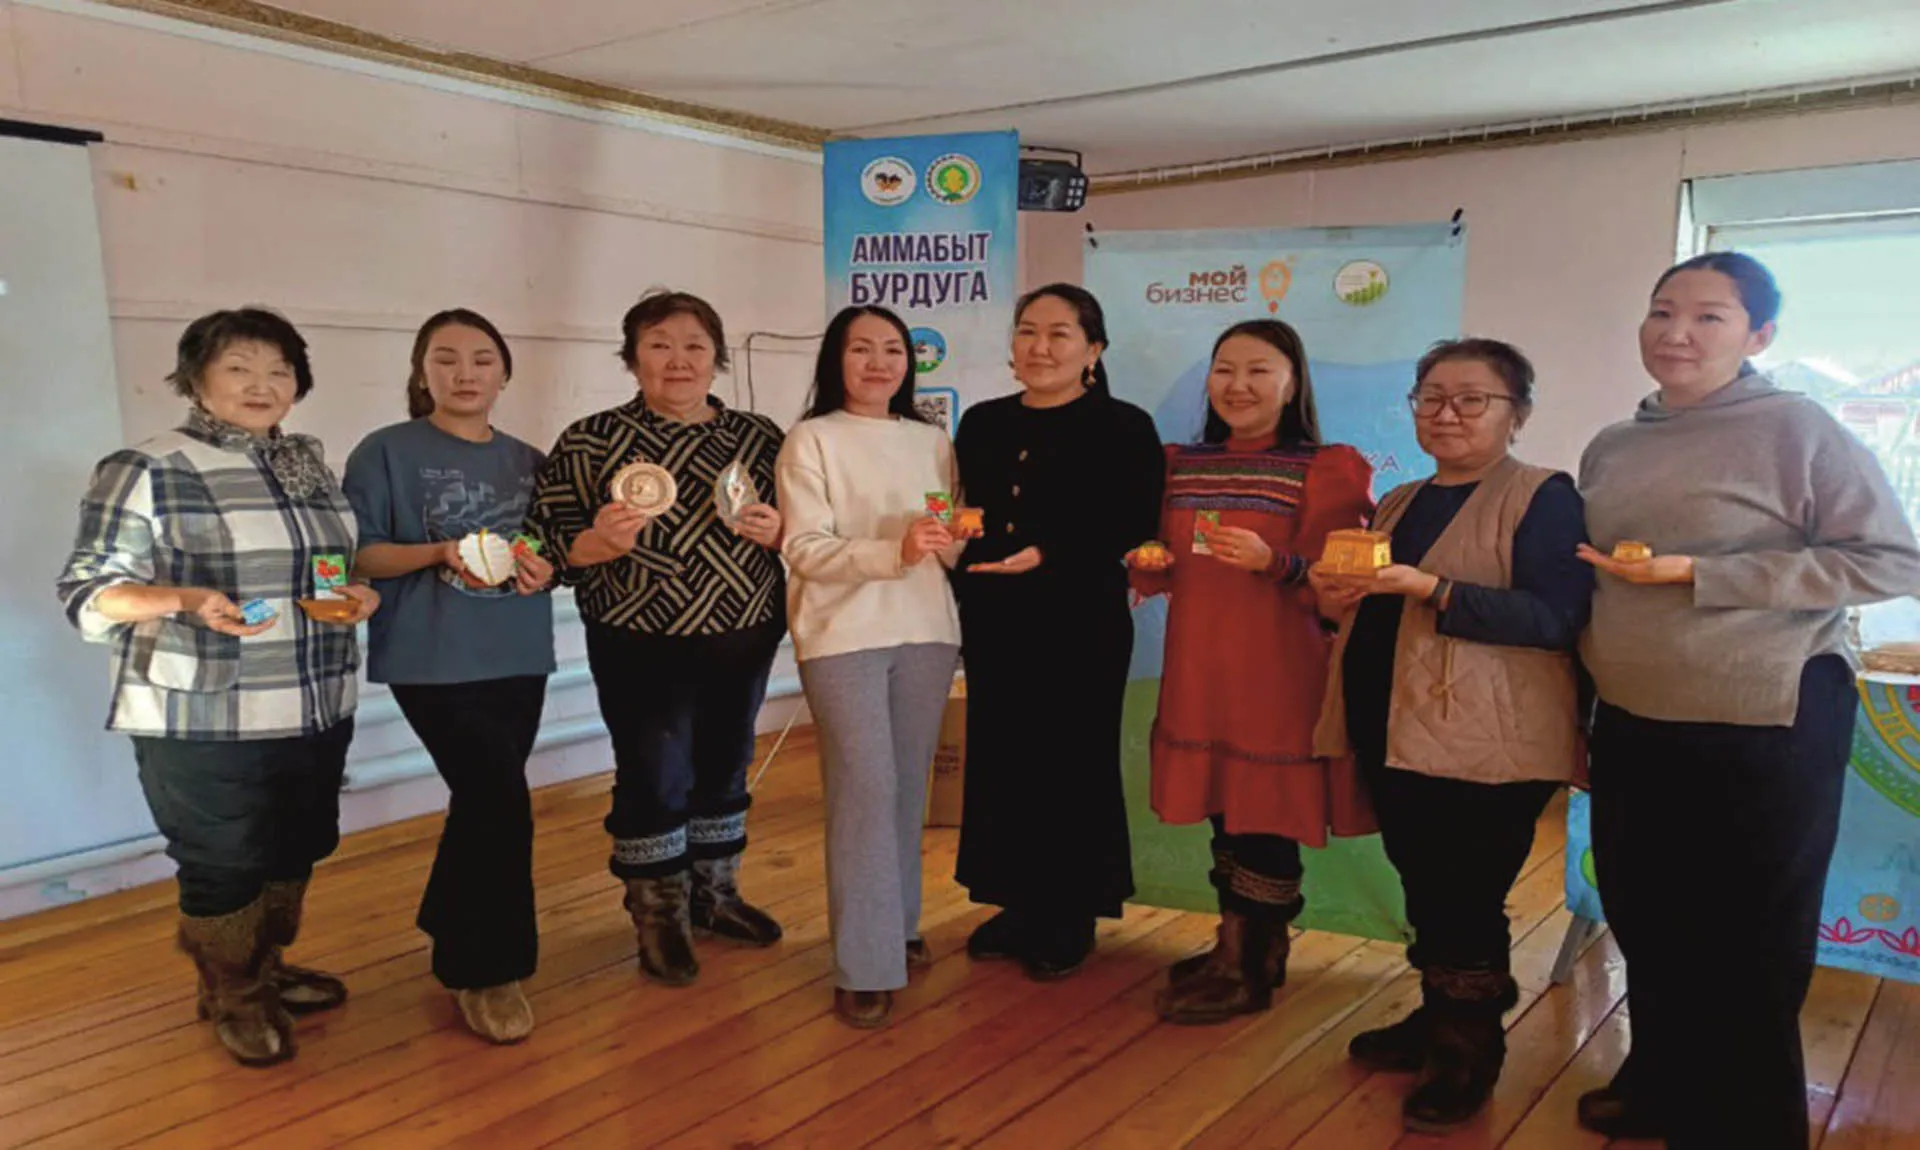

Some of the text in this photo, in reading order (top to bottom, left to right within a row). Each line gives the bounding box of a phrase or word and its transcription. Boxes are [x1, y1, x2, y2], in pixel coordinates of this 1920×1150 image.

[853, 233, 990, 262] АММАБЫТ
[1189, 265, 1247, 286] мой
[851, 271, 987, 308] БУРДУГА
[1146, 282, 1247, 304] бизнес
